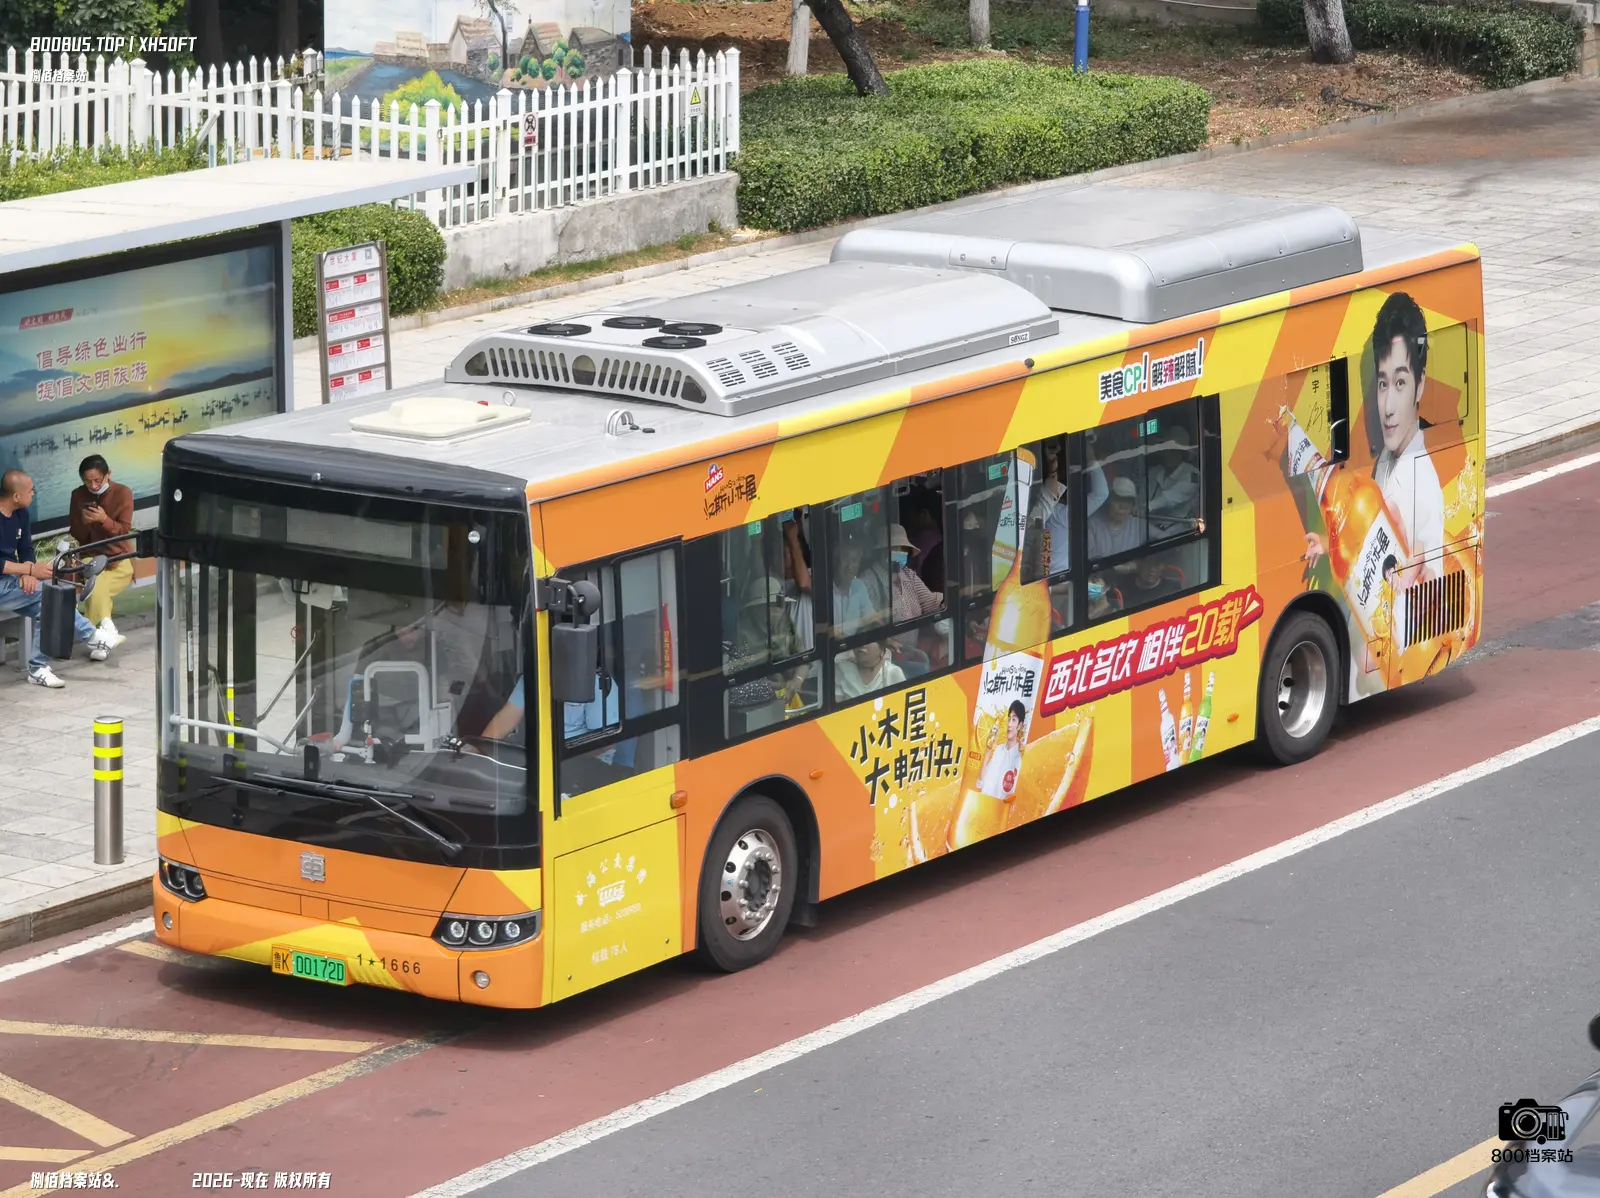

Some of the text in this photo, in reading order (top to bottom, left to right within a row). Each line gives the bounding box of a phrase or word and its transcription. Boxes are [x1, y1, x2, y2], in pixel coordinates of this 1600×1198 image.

[36, 331, 147, 371] 倡导绿色出行
[36, 361, 148, 401] 提倡文明旅游
[705, 470, 723, 491] HANS
[1044, 597, 1242, 705] 西北名饮 相伴20载
[850, 688, 927, 766] 小木屋
[865, 733, 962, 807] 大畅快!
